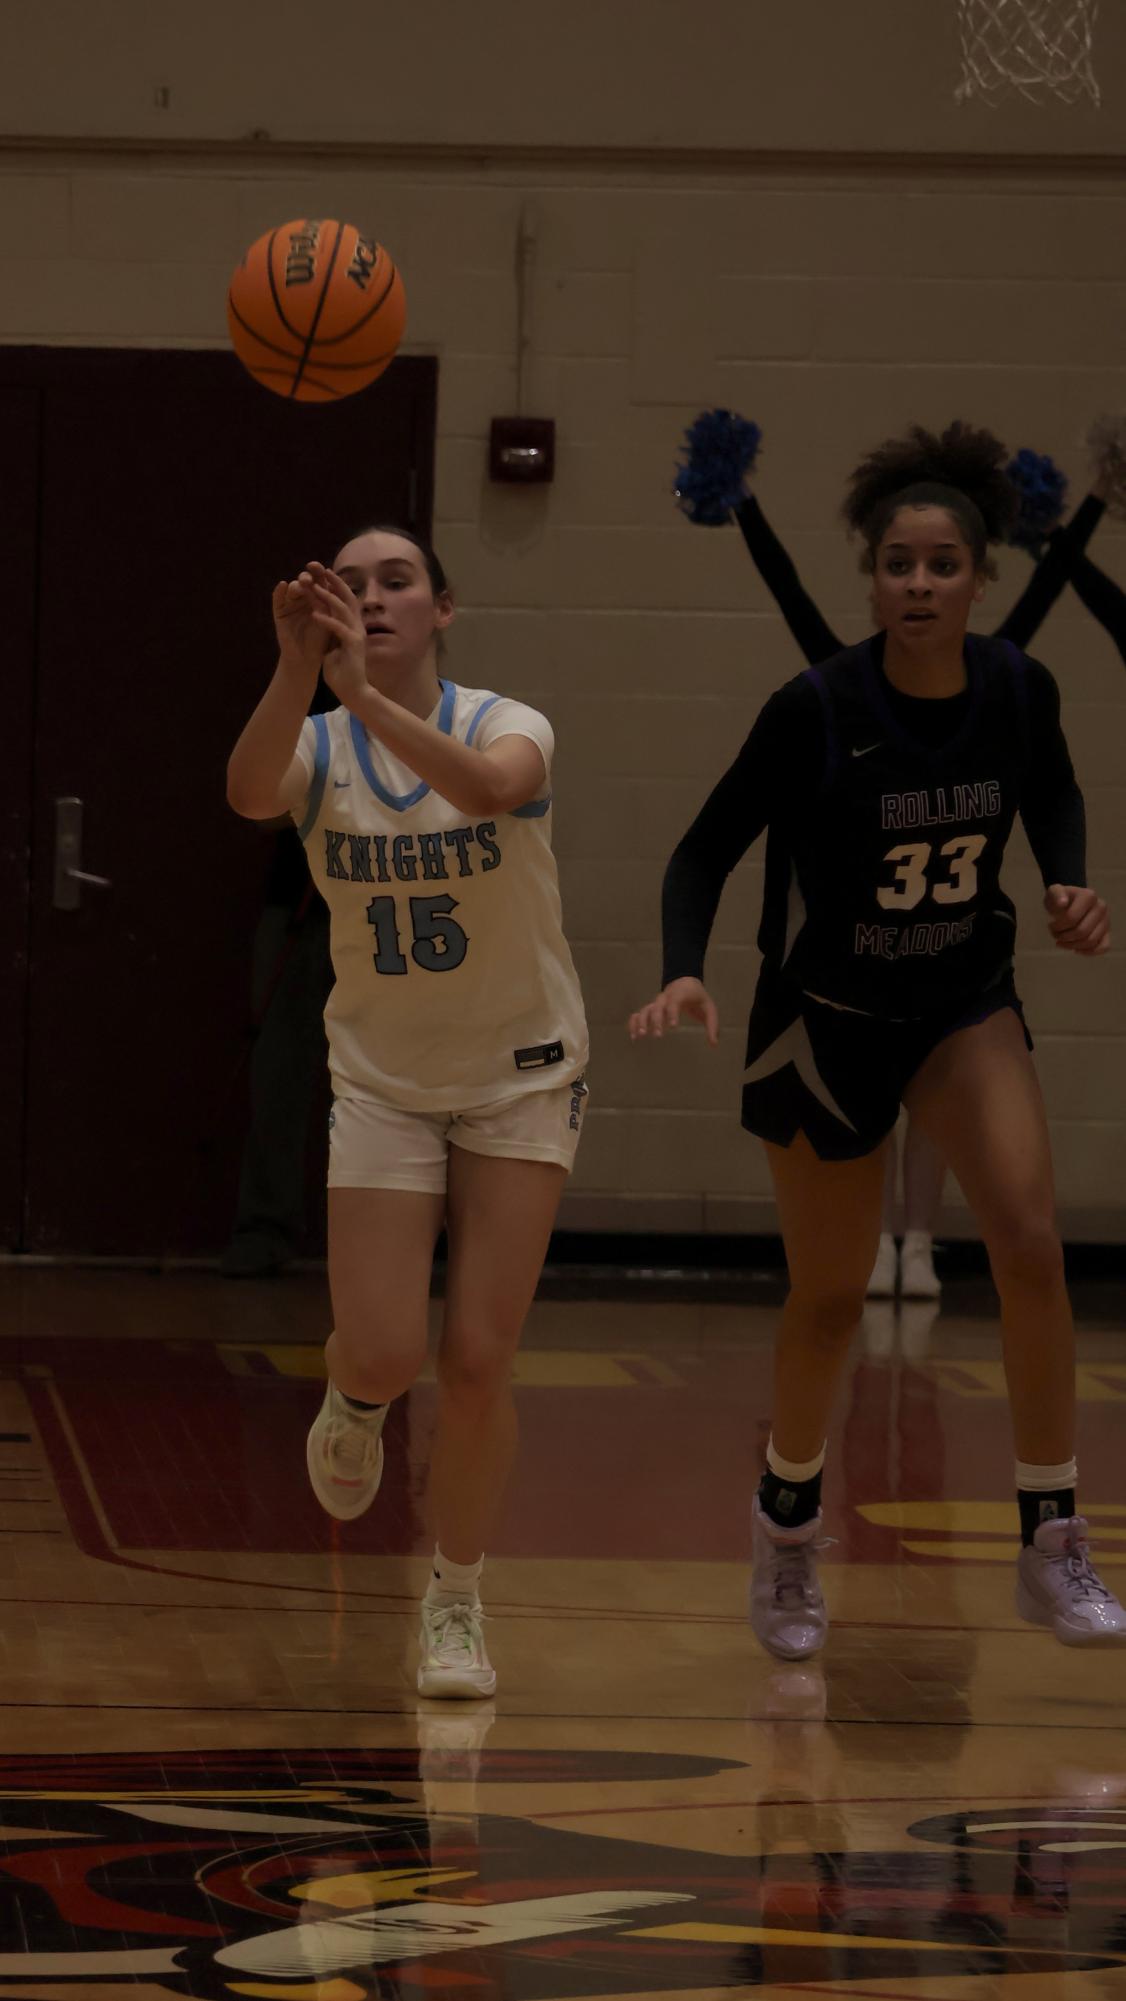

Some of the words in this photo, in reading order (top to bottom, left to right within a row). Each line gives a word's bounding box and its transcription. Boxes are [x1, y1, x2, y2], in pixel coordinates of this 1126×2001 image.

[881, 780, 1000, 830] ROLLING
[325, 821, 501, 882] KNIGHTS
[876, 833, 988, 911] 33
[366, 893, 469, 974] 15
